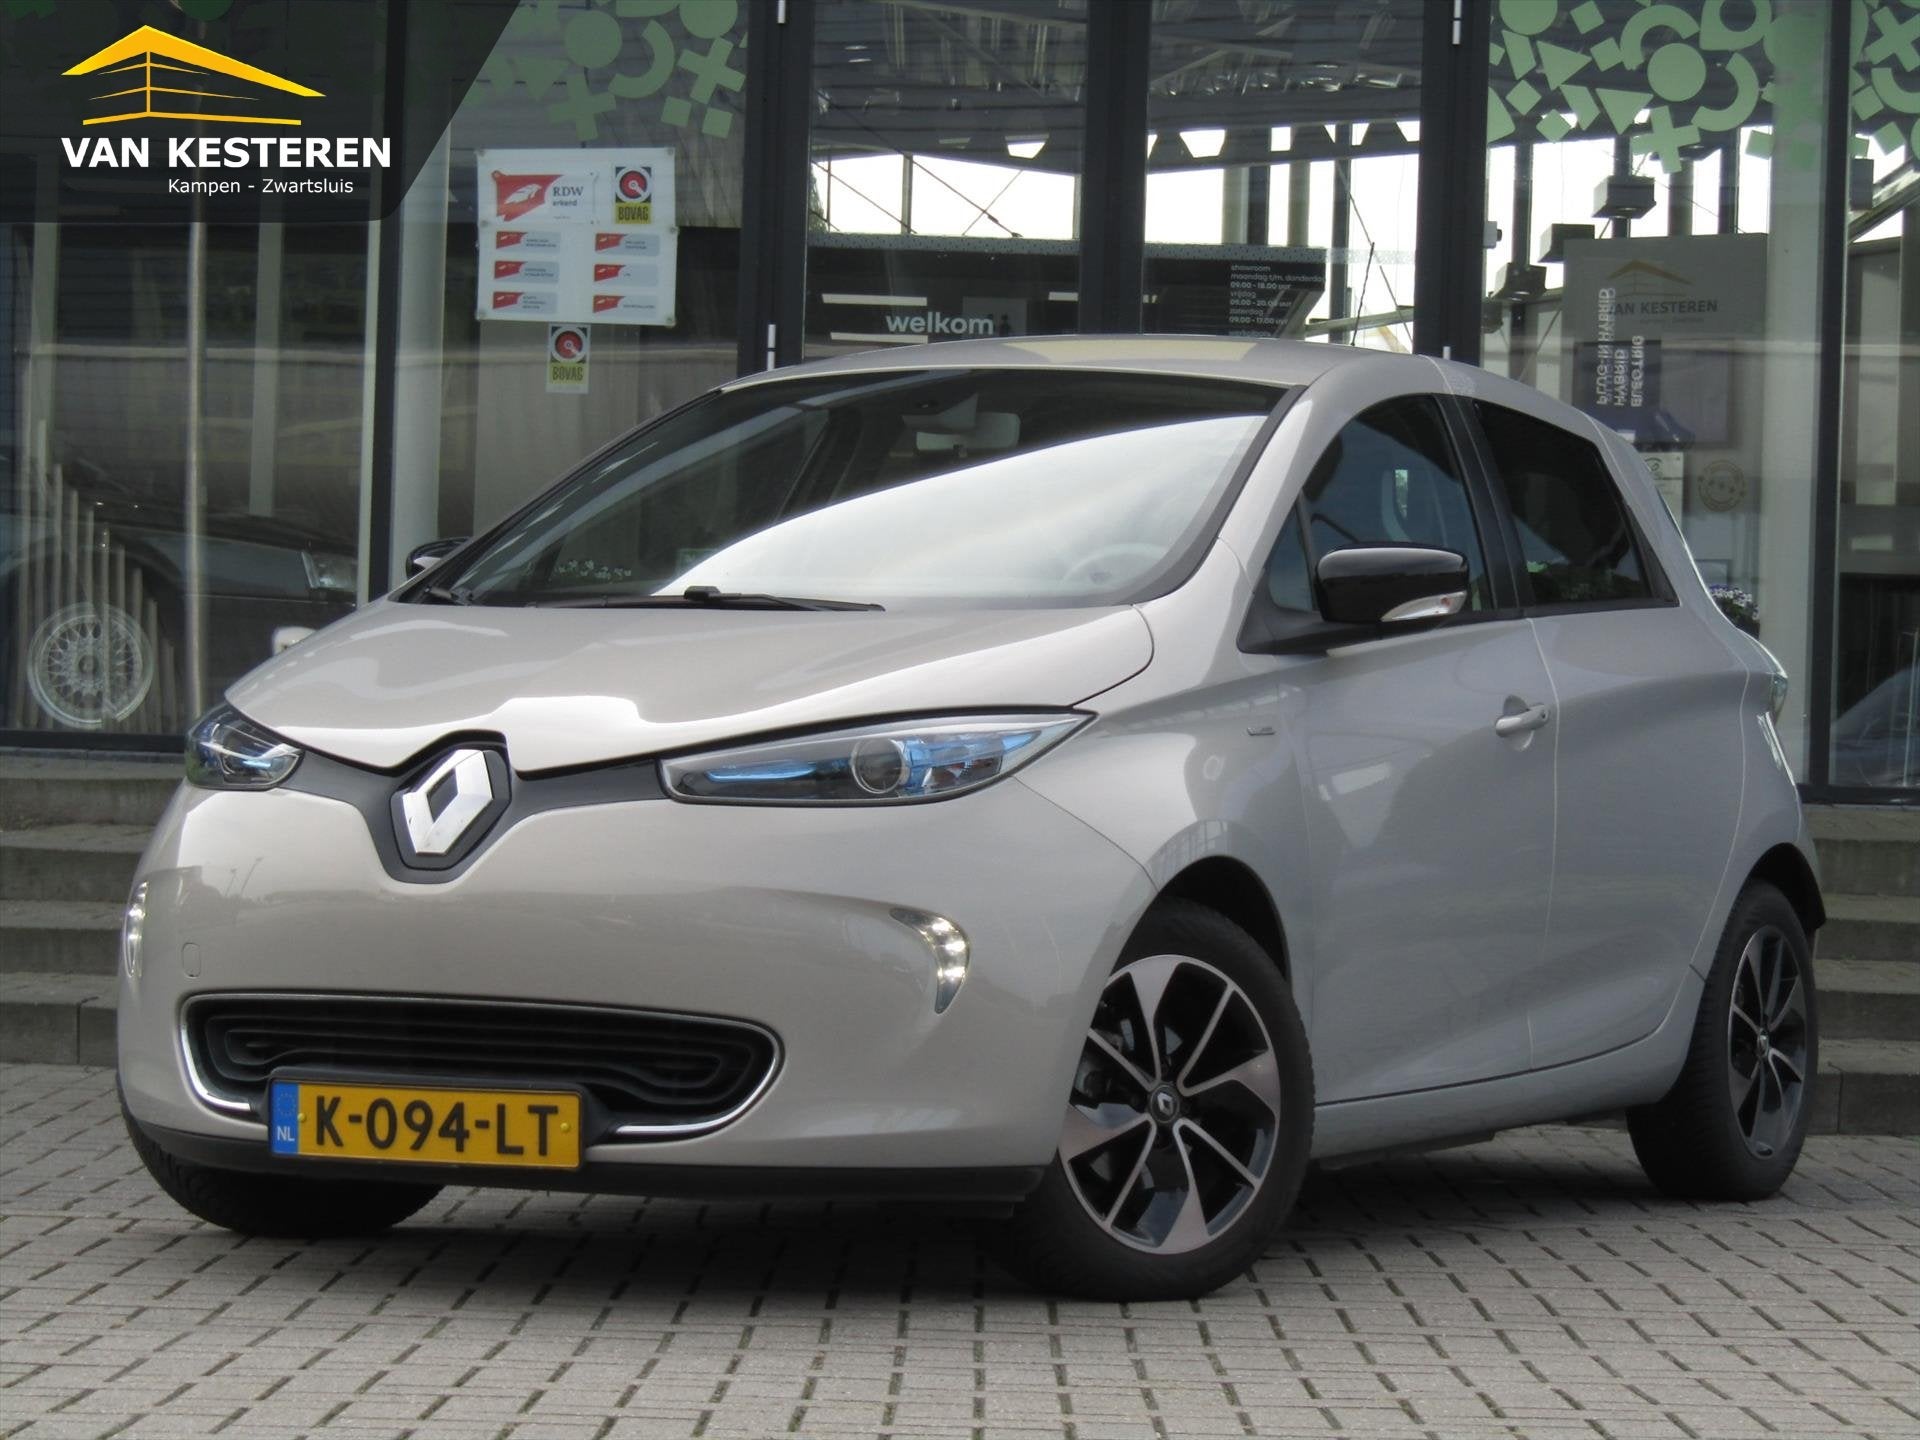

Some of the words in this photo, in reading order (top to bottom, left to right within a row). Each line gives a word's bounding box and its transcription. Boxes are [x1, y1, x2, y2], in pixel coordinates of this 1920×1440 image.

[552, 186, 584, 197] RDW
[618, 205, 649, 221] BOVAG
[1230, 281, 1252, 289] 09.00
[1607, 302, 1634, 316] AN
[1640, 300, 1718, 314] KESTEREN
[885, 311, 994, 335] welkom
[552, 366, 584, 381] BOVAG
[276, 1125, 295, 1142] NL
[315, 1095, 559, 1156] K-094-LT
